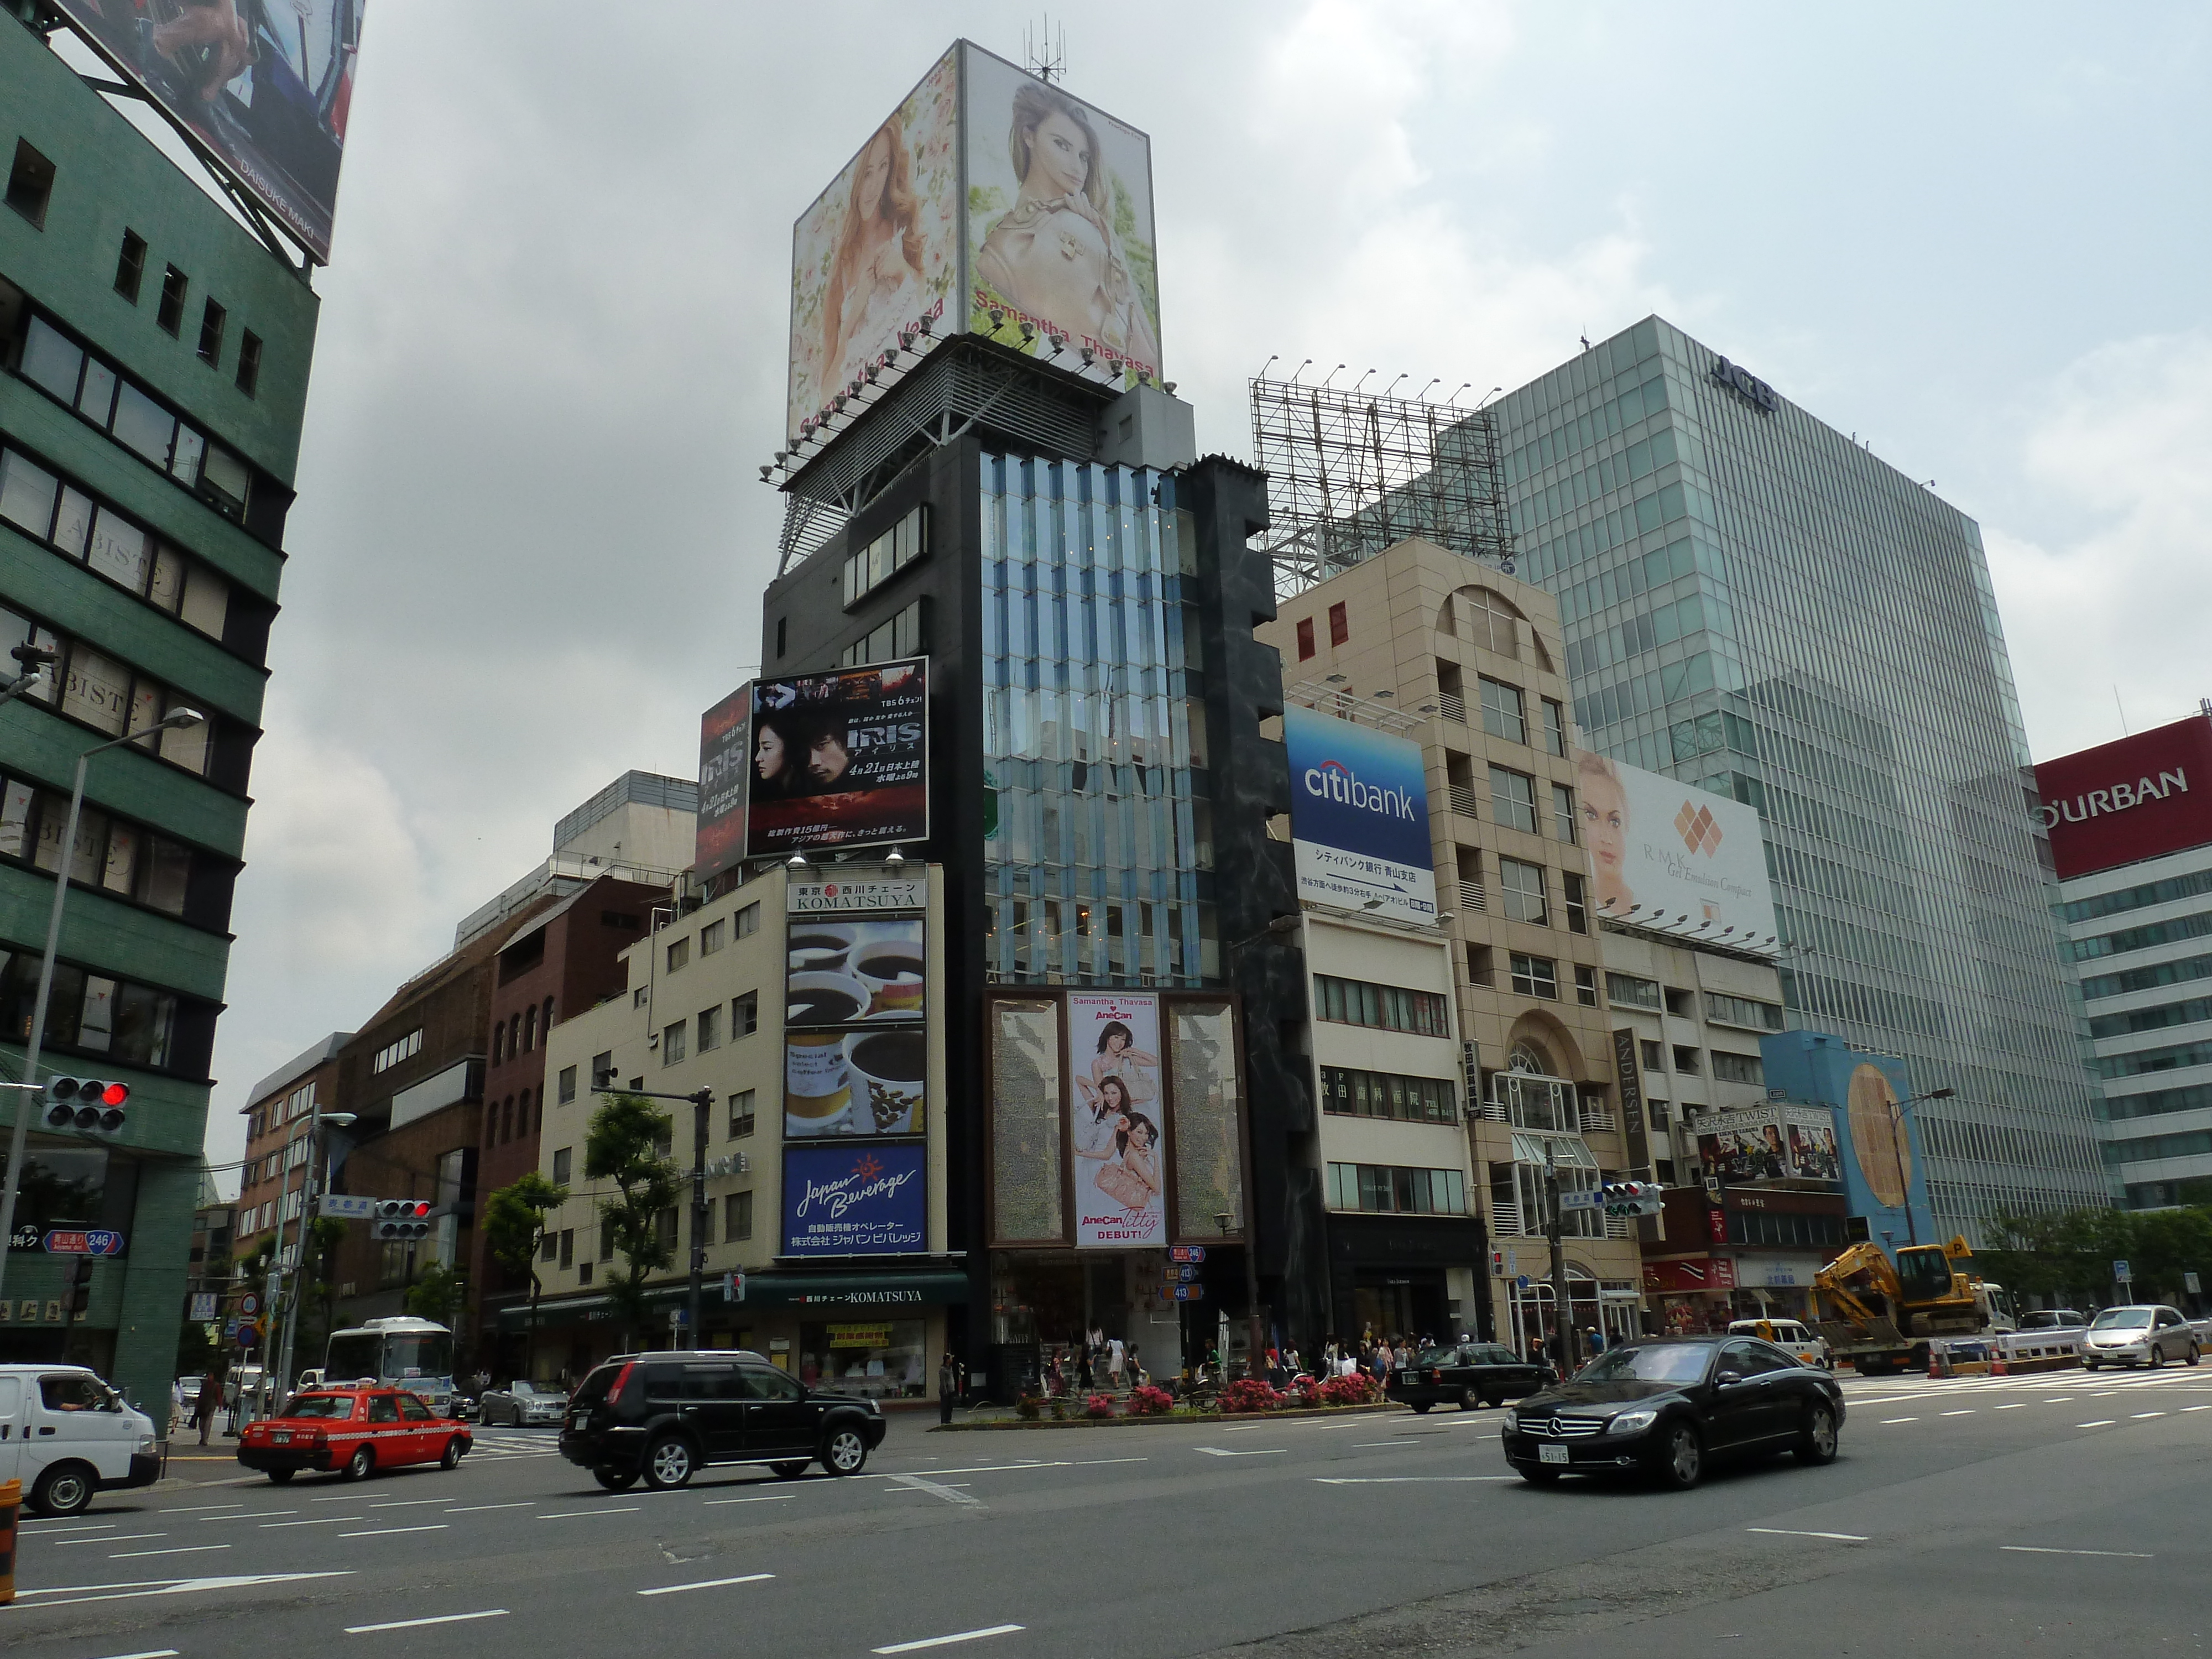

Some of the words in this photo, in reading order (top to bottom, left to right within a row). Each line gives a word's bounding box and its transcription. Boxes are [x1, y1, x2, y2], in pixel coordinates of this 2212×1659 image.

[240, 159, 287, 212] DAISUKE
[288, 206, 314, 239] MAKI
[881, 700, 896, 708] TBS
[847, 722, 922, 748] IRIS
[854, 742, 915, 757] アイリス
[701, 740, 744, 786] IRIS
[1305, 768, 1416, 822] citibank
[1315, 849, 1382, 875] シティバンク銀行
[1385, 865, 1416, 883] 青山支店
[1667, 863, 1683, 878] Gel
[1684, 867, 1719, 889] Emulsion
[1720, 877, 1752, 899] Compact
[798, 886, 821, 896] 東京
[842, 884, 915, 895] 西川チェーン
[797, 894, 917, 910] KOMATSUYA
[1073, 997, 1114, 1005] Samantha
[1095, 1011, 1133, 1020] AneCan
[1617, 1035, 1641, 1134] ANDERSEN
[1736, 1107, 1777, 1123] TWIST
[796, 1173, 860, 1218] Japan
[823, 1169, 917, 1219] Beverage
[1082, 1215, 1123, 1226] AneCan
[808, 1221, 904, 1234] 自動販売機オペレーター
[8, 1234, 38, 1247] 科ク
[89, 1234, 109, 1246] 246
[1097, 1230, 1141, 1239] DEBUT!
[790, 1235, 831, 1248] 株式会社
[1189, 1248, 1199, 1256] 246
[1954, 1244, 1962, 1254] P
[1181, 1269, 1190, 1277] 413
[850, 1290, 922, 1303] KOMATSUYA
[1175, 1288, 1187, 1297] 413
[1545, 1452, 1567, 1462] 51-15
